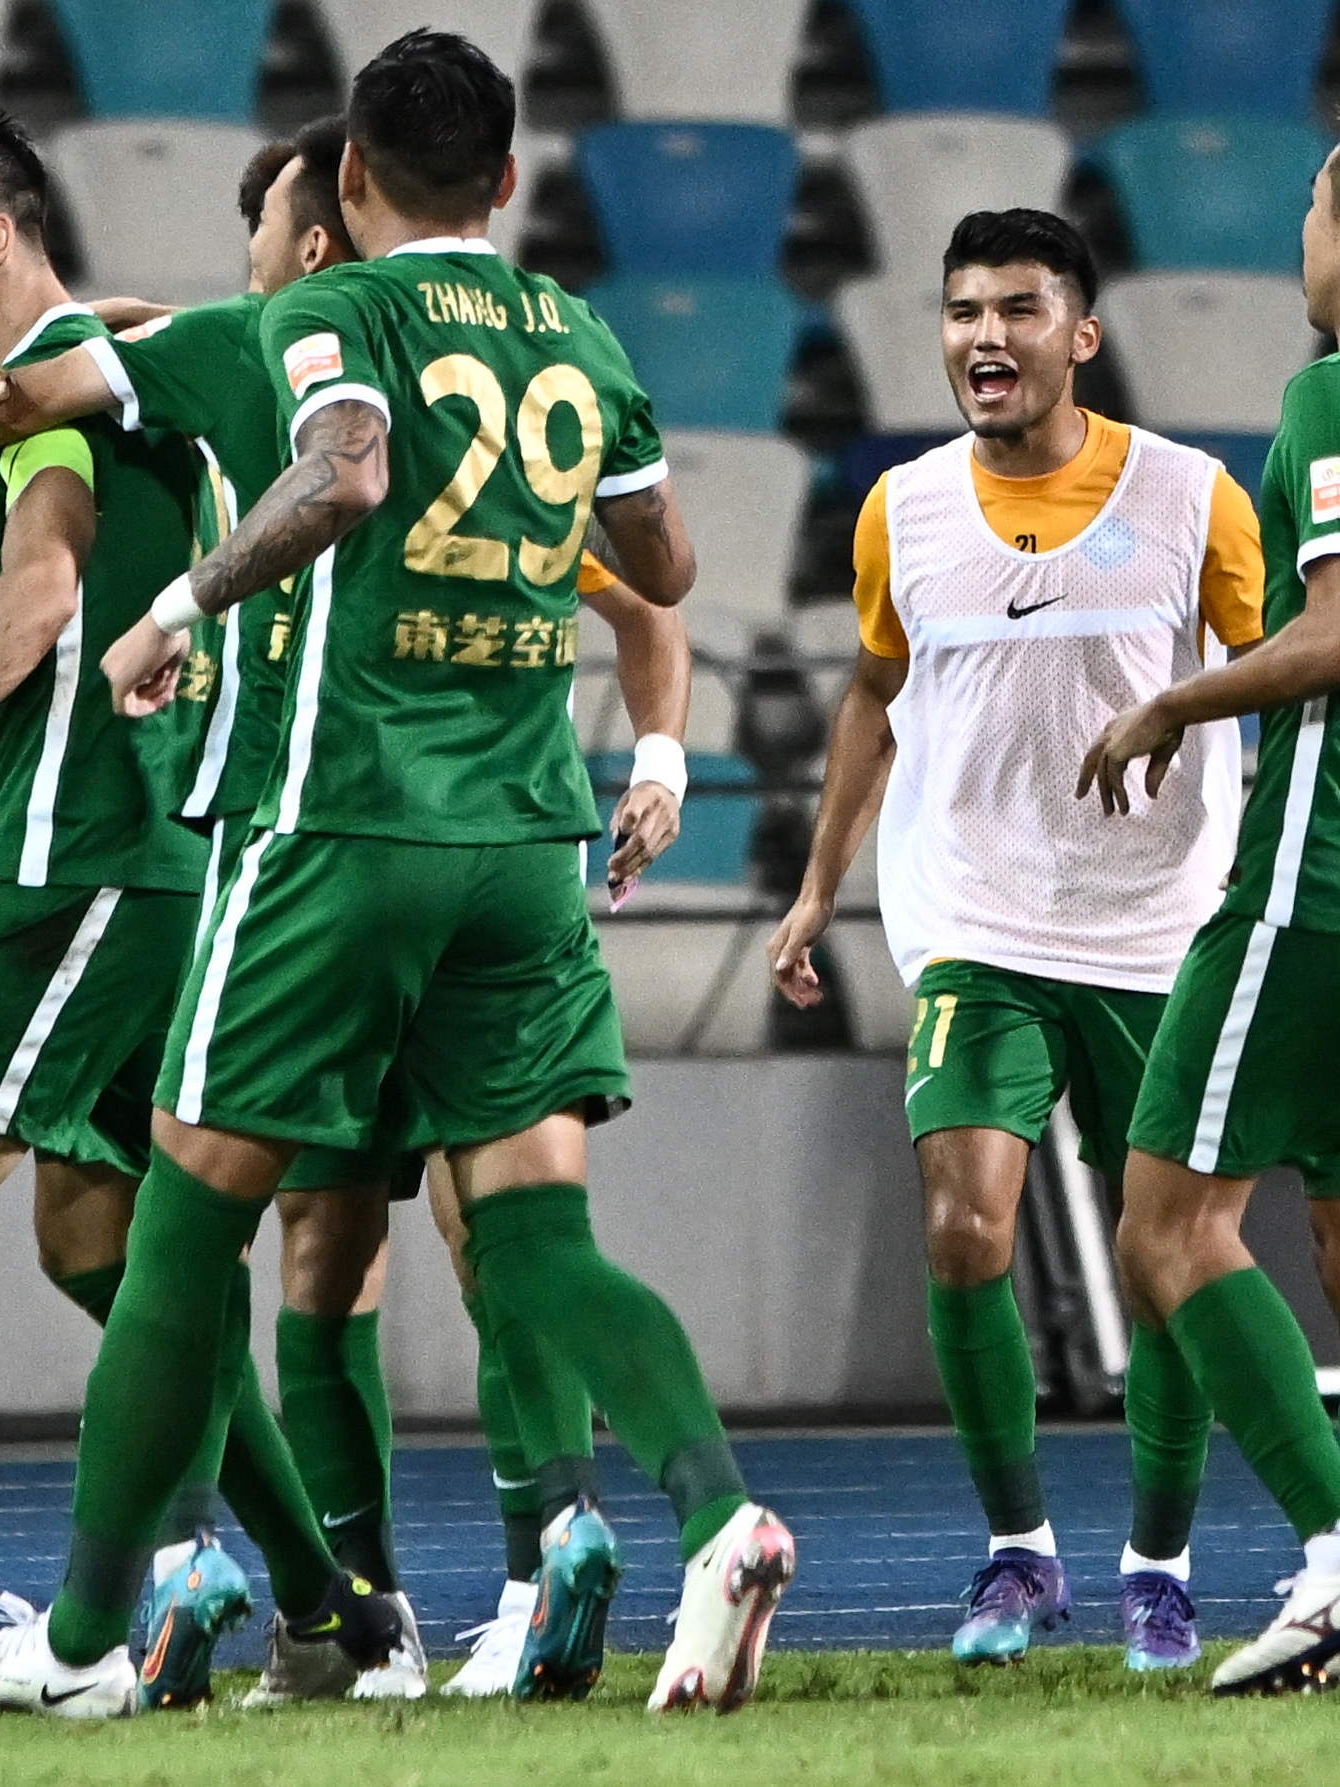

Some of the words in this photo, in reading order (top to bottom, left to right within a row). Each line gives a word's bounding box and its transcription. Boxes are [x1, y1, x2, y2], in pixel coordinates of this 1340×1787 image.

[417, 282, 508, 331] ZHANG
[519, 291, 570, 334] J.Q.
[404, 353, 604, 587] 29
[1014, 533, 1037, 555] 21
